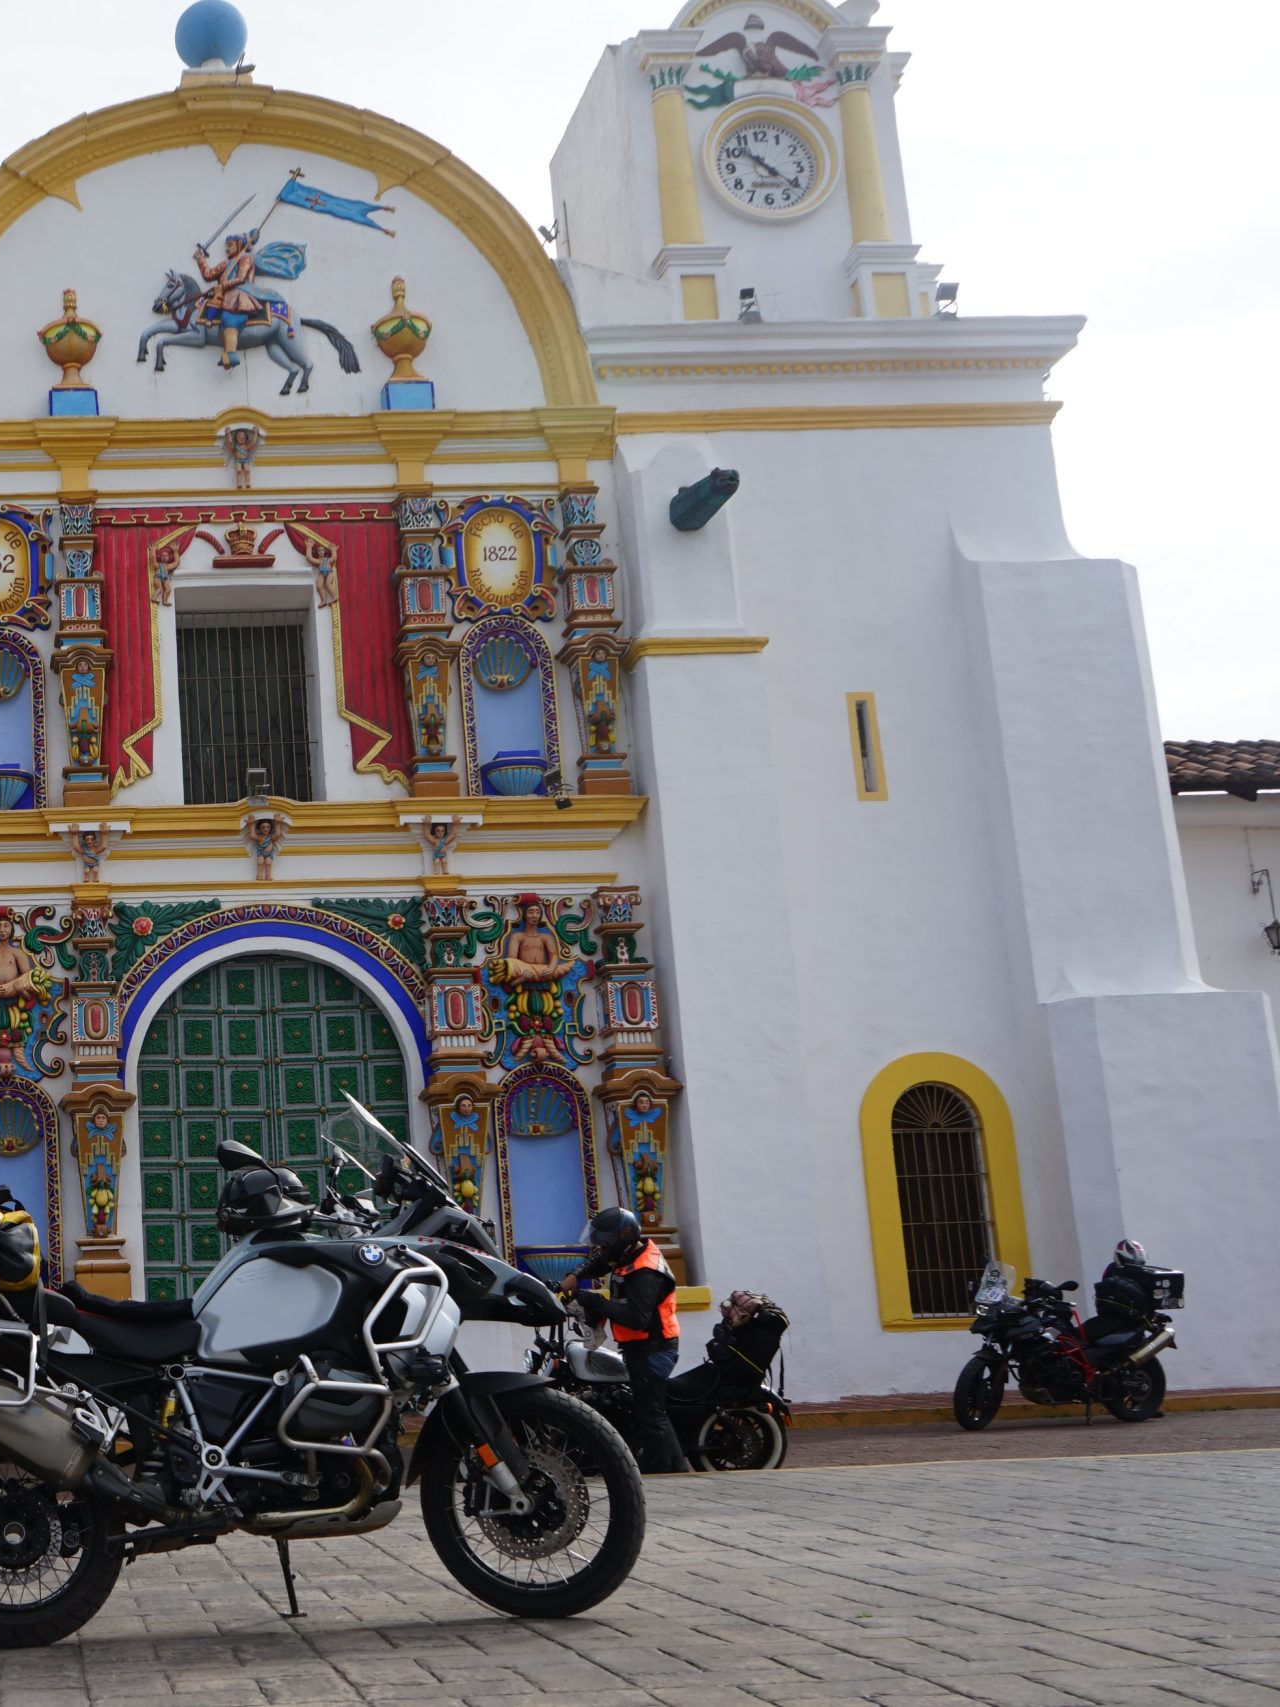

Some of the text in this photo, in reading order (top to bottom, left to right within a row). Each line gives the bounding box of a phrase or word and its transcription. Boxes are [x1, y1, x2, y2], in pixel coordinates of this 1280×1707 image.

[736, 134, 748, 147] 11
[753, 130, 768, 143] 12
[773, 134, 780, 146] 1
[725, 146, 742, 159] 10
[788, 144, 798, 157] 2
[725, 163, 736, 175] 9
[793, 160, 804, 174] 3
[733, 178, 744, 191] 8
[788, 176, 801, 188] 4
[746, 189, 757, 204] 7
[764, 193, 775, 206] 6
[781, 188, 791, 201] 5
[508, 521, 524, 539] de
[4, 531, 22, 550] de
[483, 545, 517, 562] 1822
[470, 568, 529, 605] Restauración
